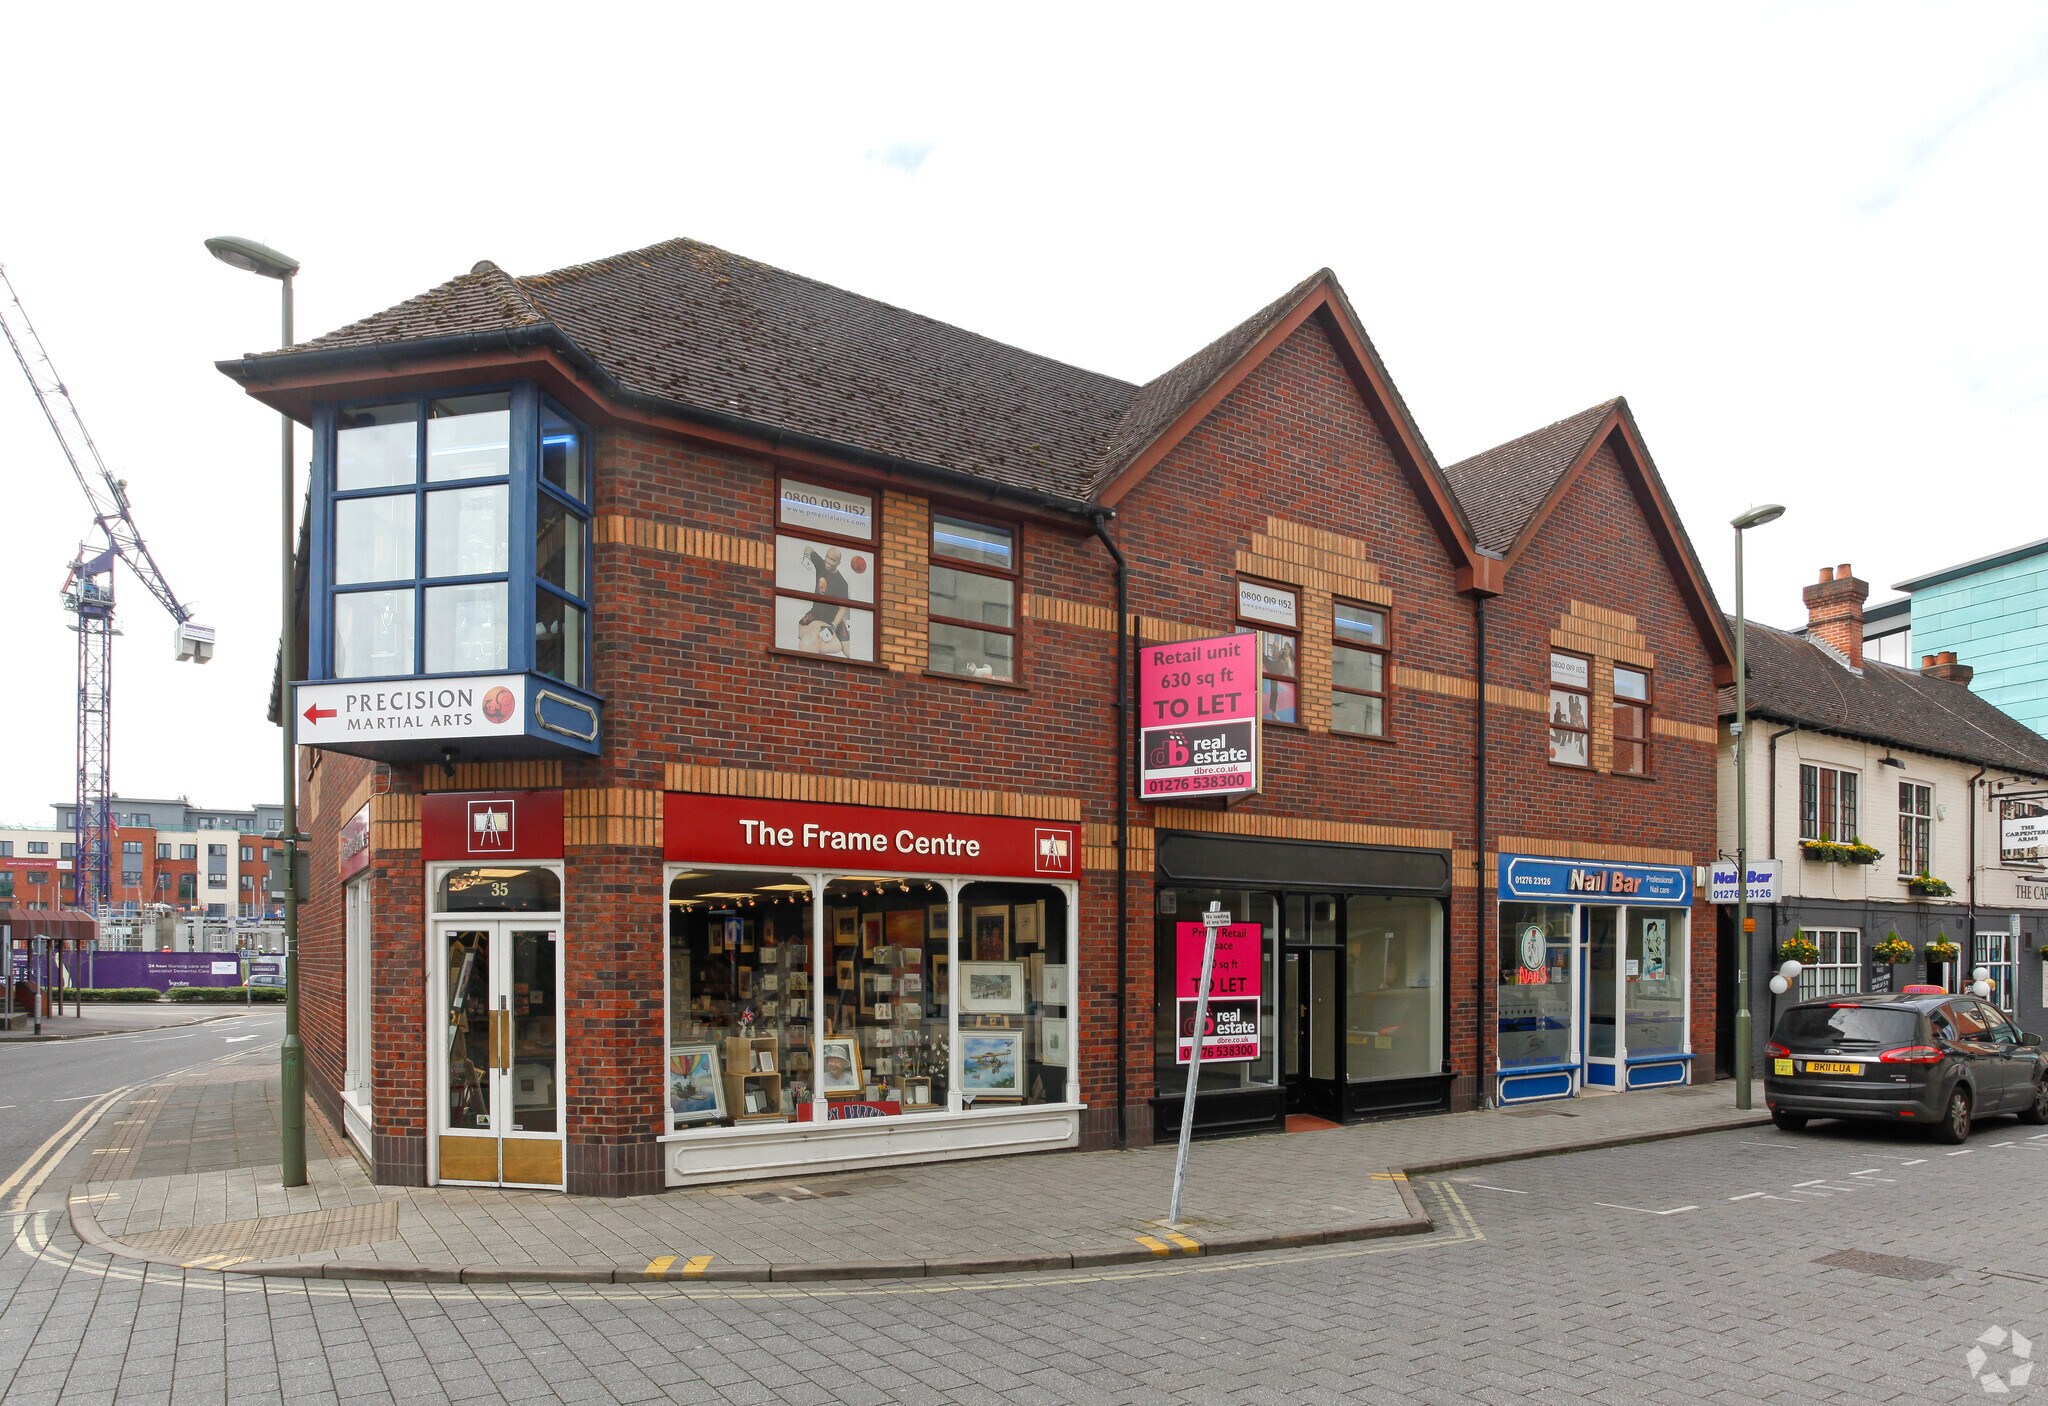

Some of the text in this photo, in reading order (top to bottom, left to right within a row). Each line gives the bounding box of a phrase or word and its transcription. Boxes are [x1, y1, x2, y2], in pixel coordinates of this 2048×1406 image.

[784, 491, 867, 517] 0800 019 1152
[1241, 590, 1292, 610] 0800 019 1152
[1153, 642, 1241, 666] Retail unit
[1161, 667, 1234, 689] 630 sq ft
[346, 689, 473, 712] PRECISION
[1153, 692, 1242, 719] TO LET
[347, 713, 473, 730] MARTIAL ARTS
[1193, 733, 1226, 751] real
[1193, 747, 1248, 764] estate
[1193, 764, 1239, 775] dbre.co.uk
[1149, 774, 1245, 793] 01276 538300
[739, 819, 981, 858] The Frame Centre
[2005, 829, 2048, 837] CARPENTER
[1515, 868, 1642, 893] 01276 23126 Nail Bar
[1645, 875, 1674, 884] Professional
[1713, 870, 1772, 884] Nai Bar
[491, 882, 509, 897] 35
[1649, 886, 1670, 894] Nail care
[1713, 889, 1740, 899] 01276
[2015, 885, 2031, 900] THE
[1221, 928, 1247, 938] Retail
[1220, 961, 1229, 971] sq
[1231, 959, 1239, 969] ft
[1519, 965, 1548, 985] NAILS
[1220, 977, 1247, 993] LET
[1217, 1008, 1240, 1022] real
[1216, 1021, 1255, 1034] estate
[1216, 1036, 1249, 1044] dbre.co.uk
[1216, 1044, 1253, 1057] 538300
[1832, 1064, 1851, 1073] LUA
